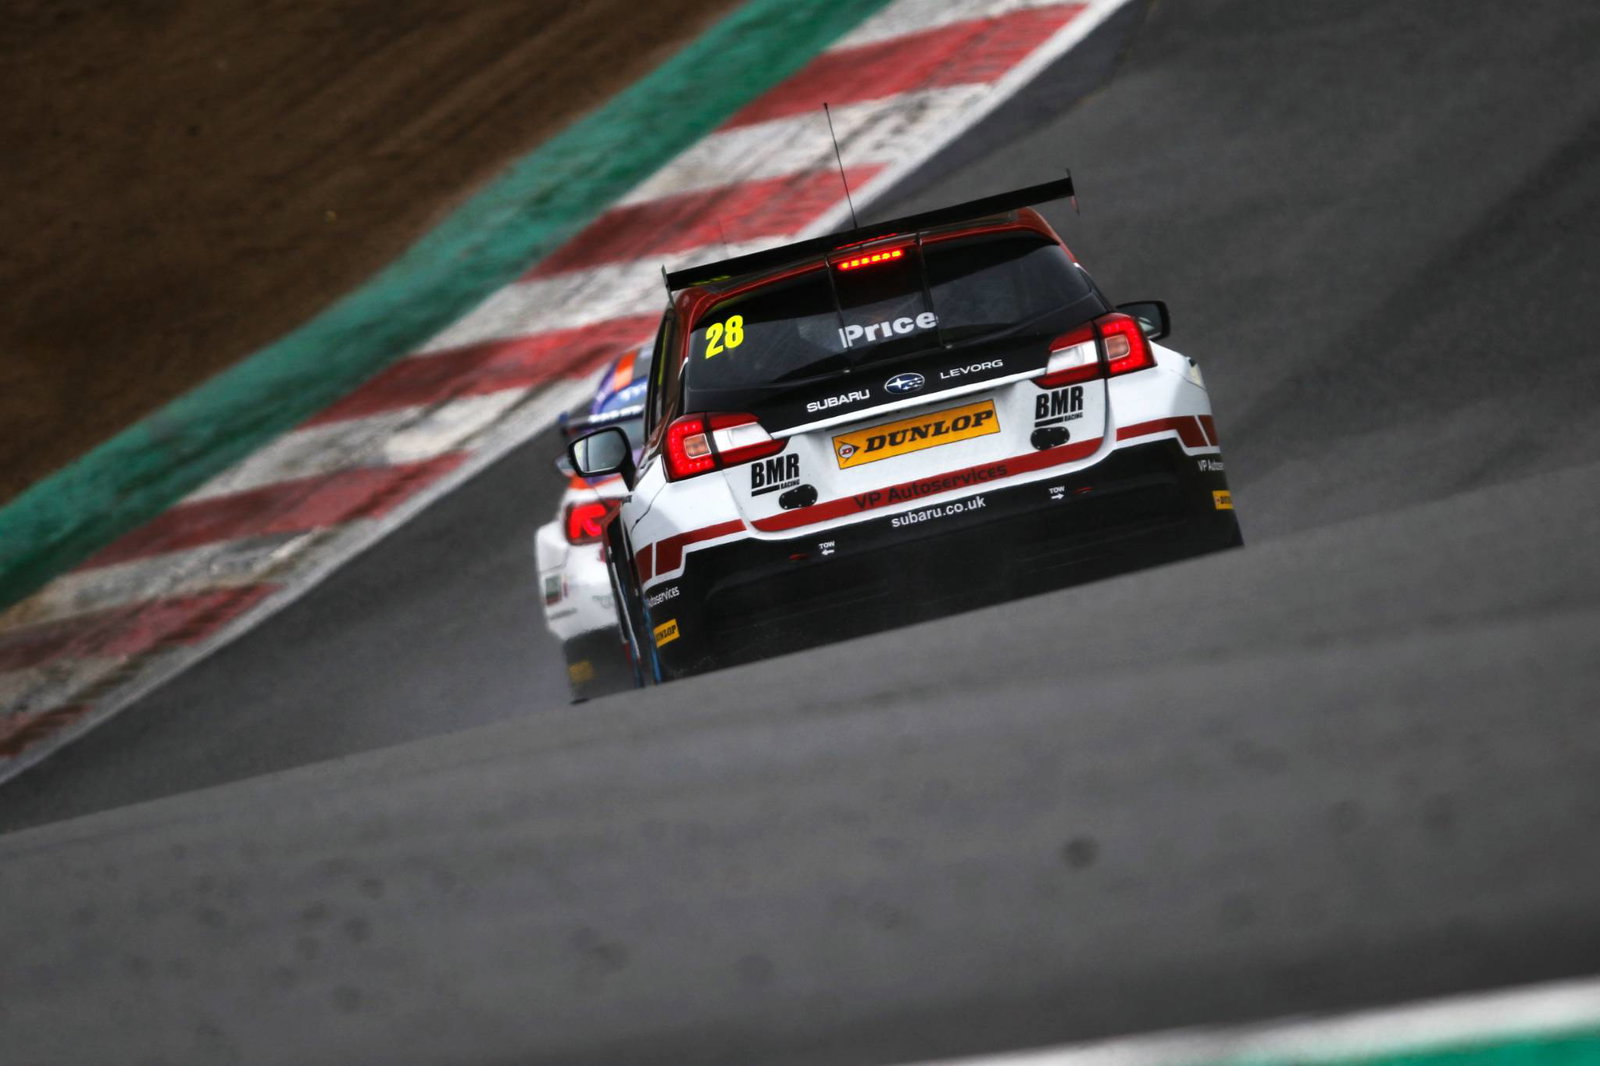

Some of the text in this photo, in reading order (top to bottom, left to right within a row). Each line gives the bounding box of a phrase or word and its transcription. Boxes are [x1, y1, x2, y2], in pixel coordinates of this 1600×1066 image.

[705, 315, 744, 359] 28
[838, 312, 938, 348] Price
[806, 359, 1003, 413] SUBARU LEVORG
[1035, 385, 1083, 420] BMR
[864, 410, 993, 452] DUNLOP
[751, 453, 799, 489] BMR
[780, 479, 800, 489] RACING
[852, 464, 1008, 509] VP Autoservices
[1048, 486, 1065, 494] TOW
[891, 495, 986, 527] subaru.co.uk
[818, 541, 835, 549] TOW
